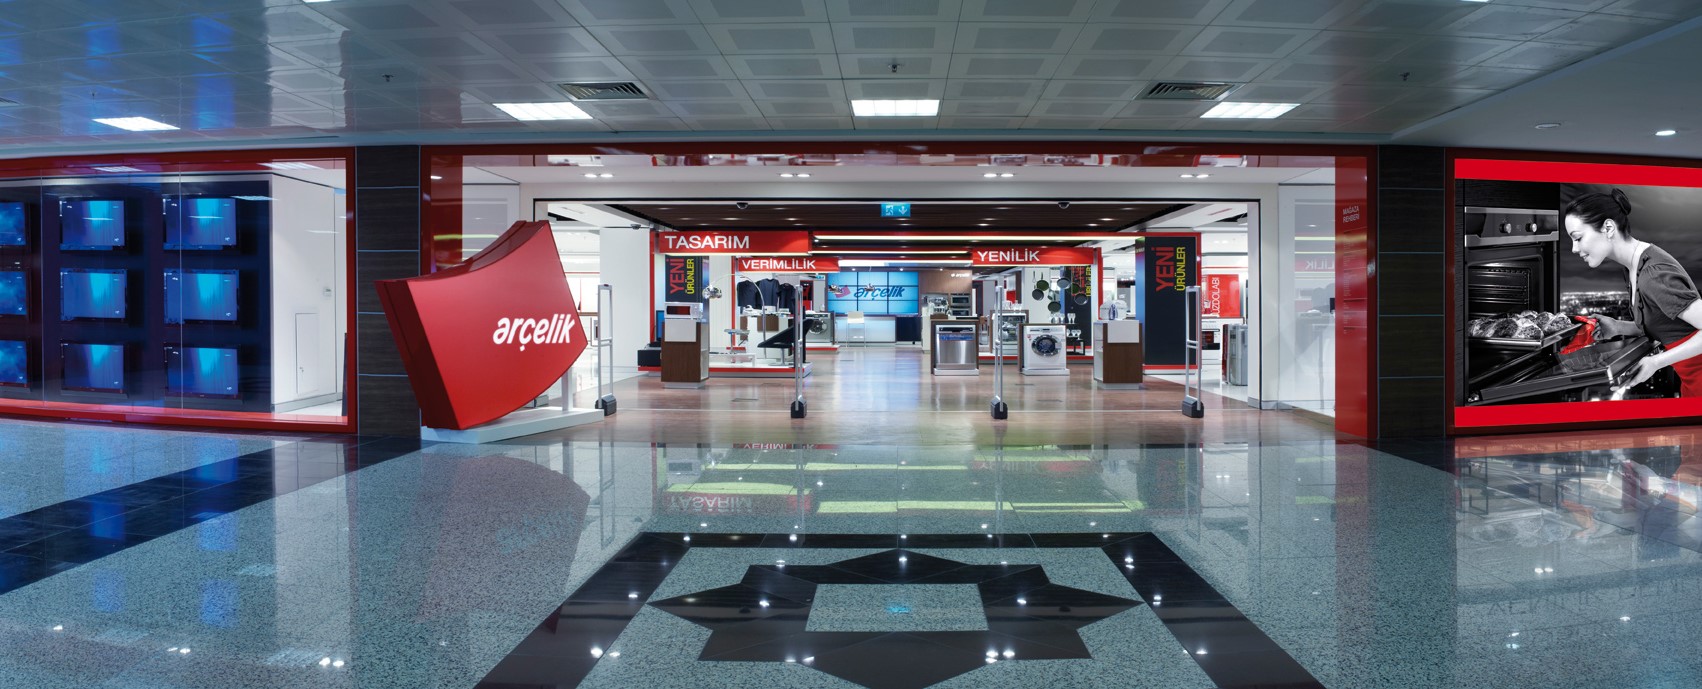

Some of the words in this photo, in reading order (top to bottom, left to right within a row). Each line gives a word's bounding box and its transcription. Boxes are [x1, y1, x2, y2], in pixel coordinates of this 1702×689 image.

[664, 235, 750, 249] TASARIM
[977, 248, 1040, 262] YENİLİK
[666, 258, 685, 295] YENİ
[686, 258, 695, 295] ÜRÜNLER
[741, 258, 816, 270] VERİMLİLİK
[1151, 246, 1174, 292] YENİ
[1174, 246, 1186, 291] ÜRÜNLER
[853, 286, 906, 301] arçelik
[492, 313, 576, 352] arçelik
